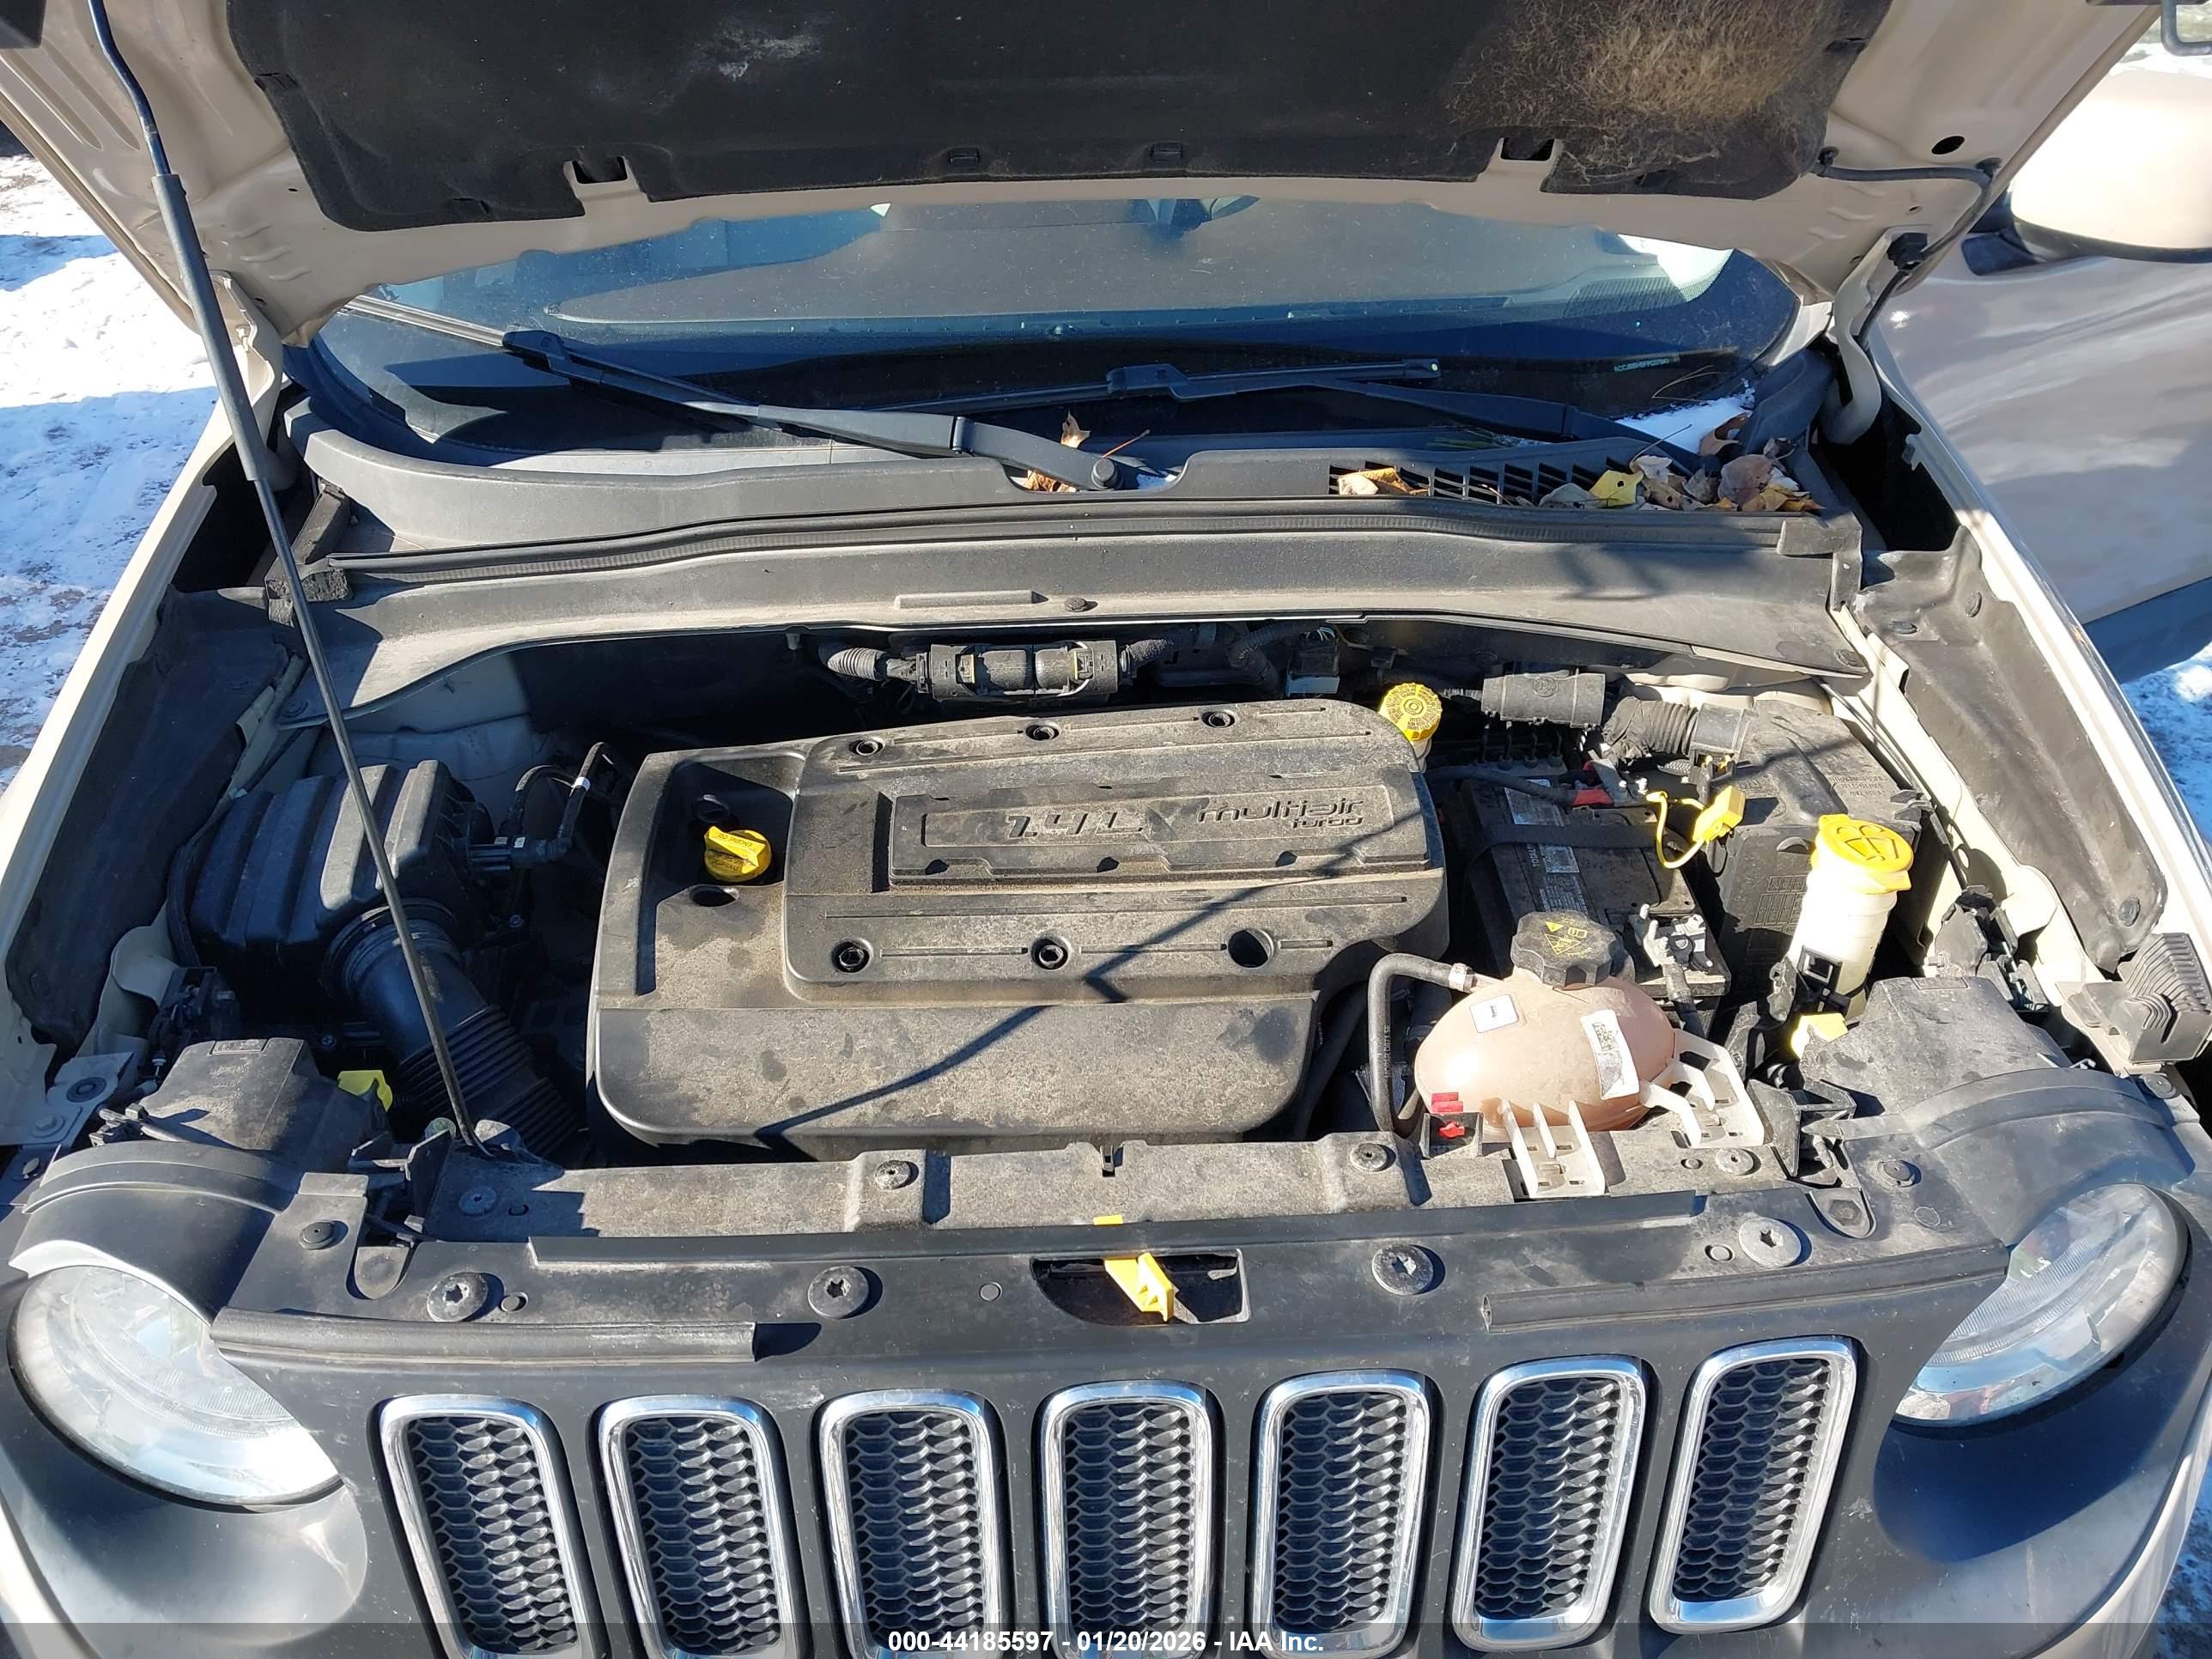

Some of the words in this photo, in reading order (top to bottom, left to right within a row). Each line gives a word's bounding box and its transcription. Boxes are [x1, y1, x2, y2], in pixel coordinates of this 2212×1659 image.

[1197, 798, 1364, 823] multiair
[1291, 816, 1364, 830] turbo
[728, 836, 753, 848] ENGINE
